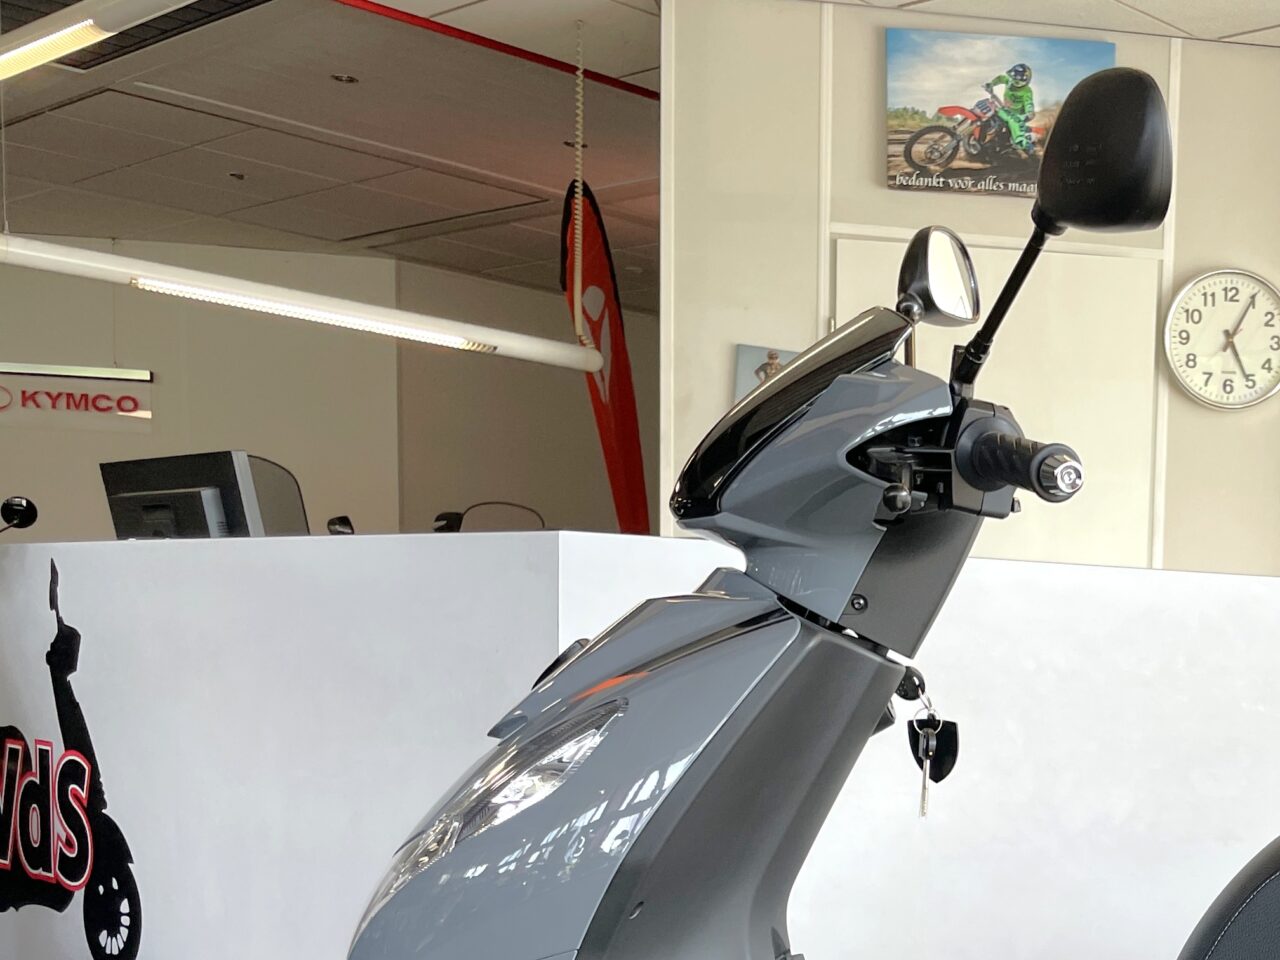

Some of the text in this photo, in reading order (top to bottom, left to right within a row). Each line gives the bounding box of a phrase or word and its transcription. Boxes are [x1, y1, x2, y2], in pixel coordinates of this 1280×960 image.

[895, 171, 944, 188] bedankt
[948, 177, 975, 189] voor
[977, 175, 1004, 191] alles
[1201, 291, 1216, 307] 11
[1222, 286, 1240, 303] 12
[1184, 308, 1202, 325] 10
[1263, 311, 1276, 328] 2
[1178, 329, 1190, 345] 9
[1269, 335, 1280, 351] 3
[1185, 353, 1197, 369] 8
[1261, 357, 1273, 374] 4
[1202, 371, 1213, 388] 7
[1222, 378, 1234, 395] 6
[1244, 373, 1257, 389] 5
[20, 389, 140, 413] KYMCO
